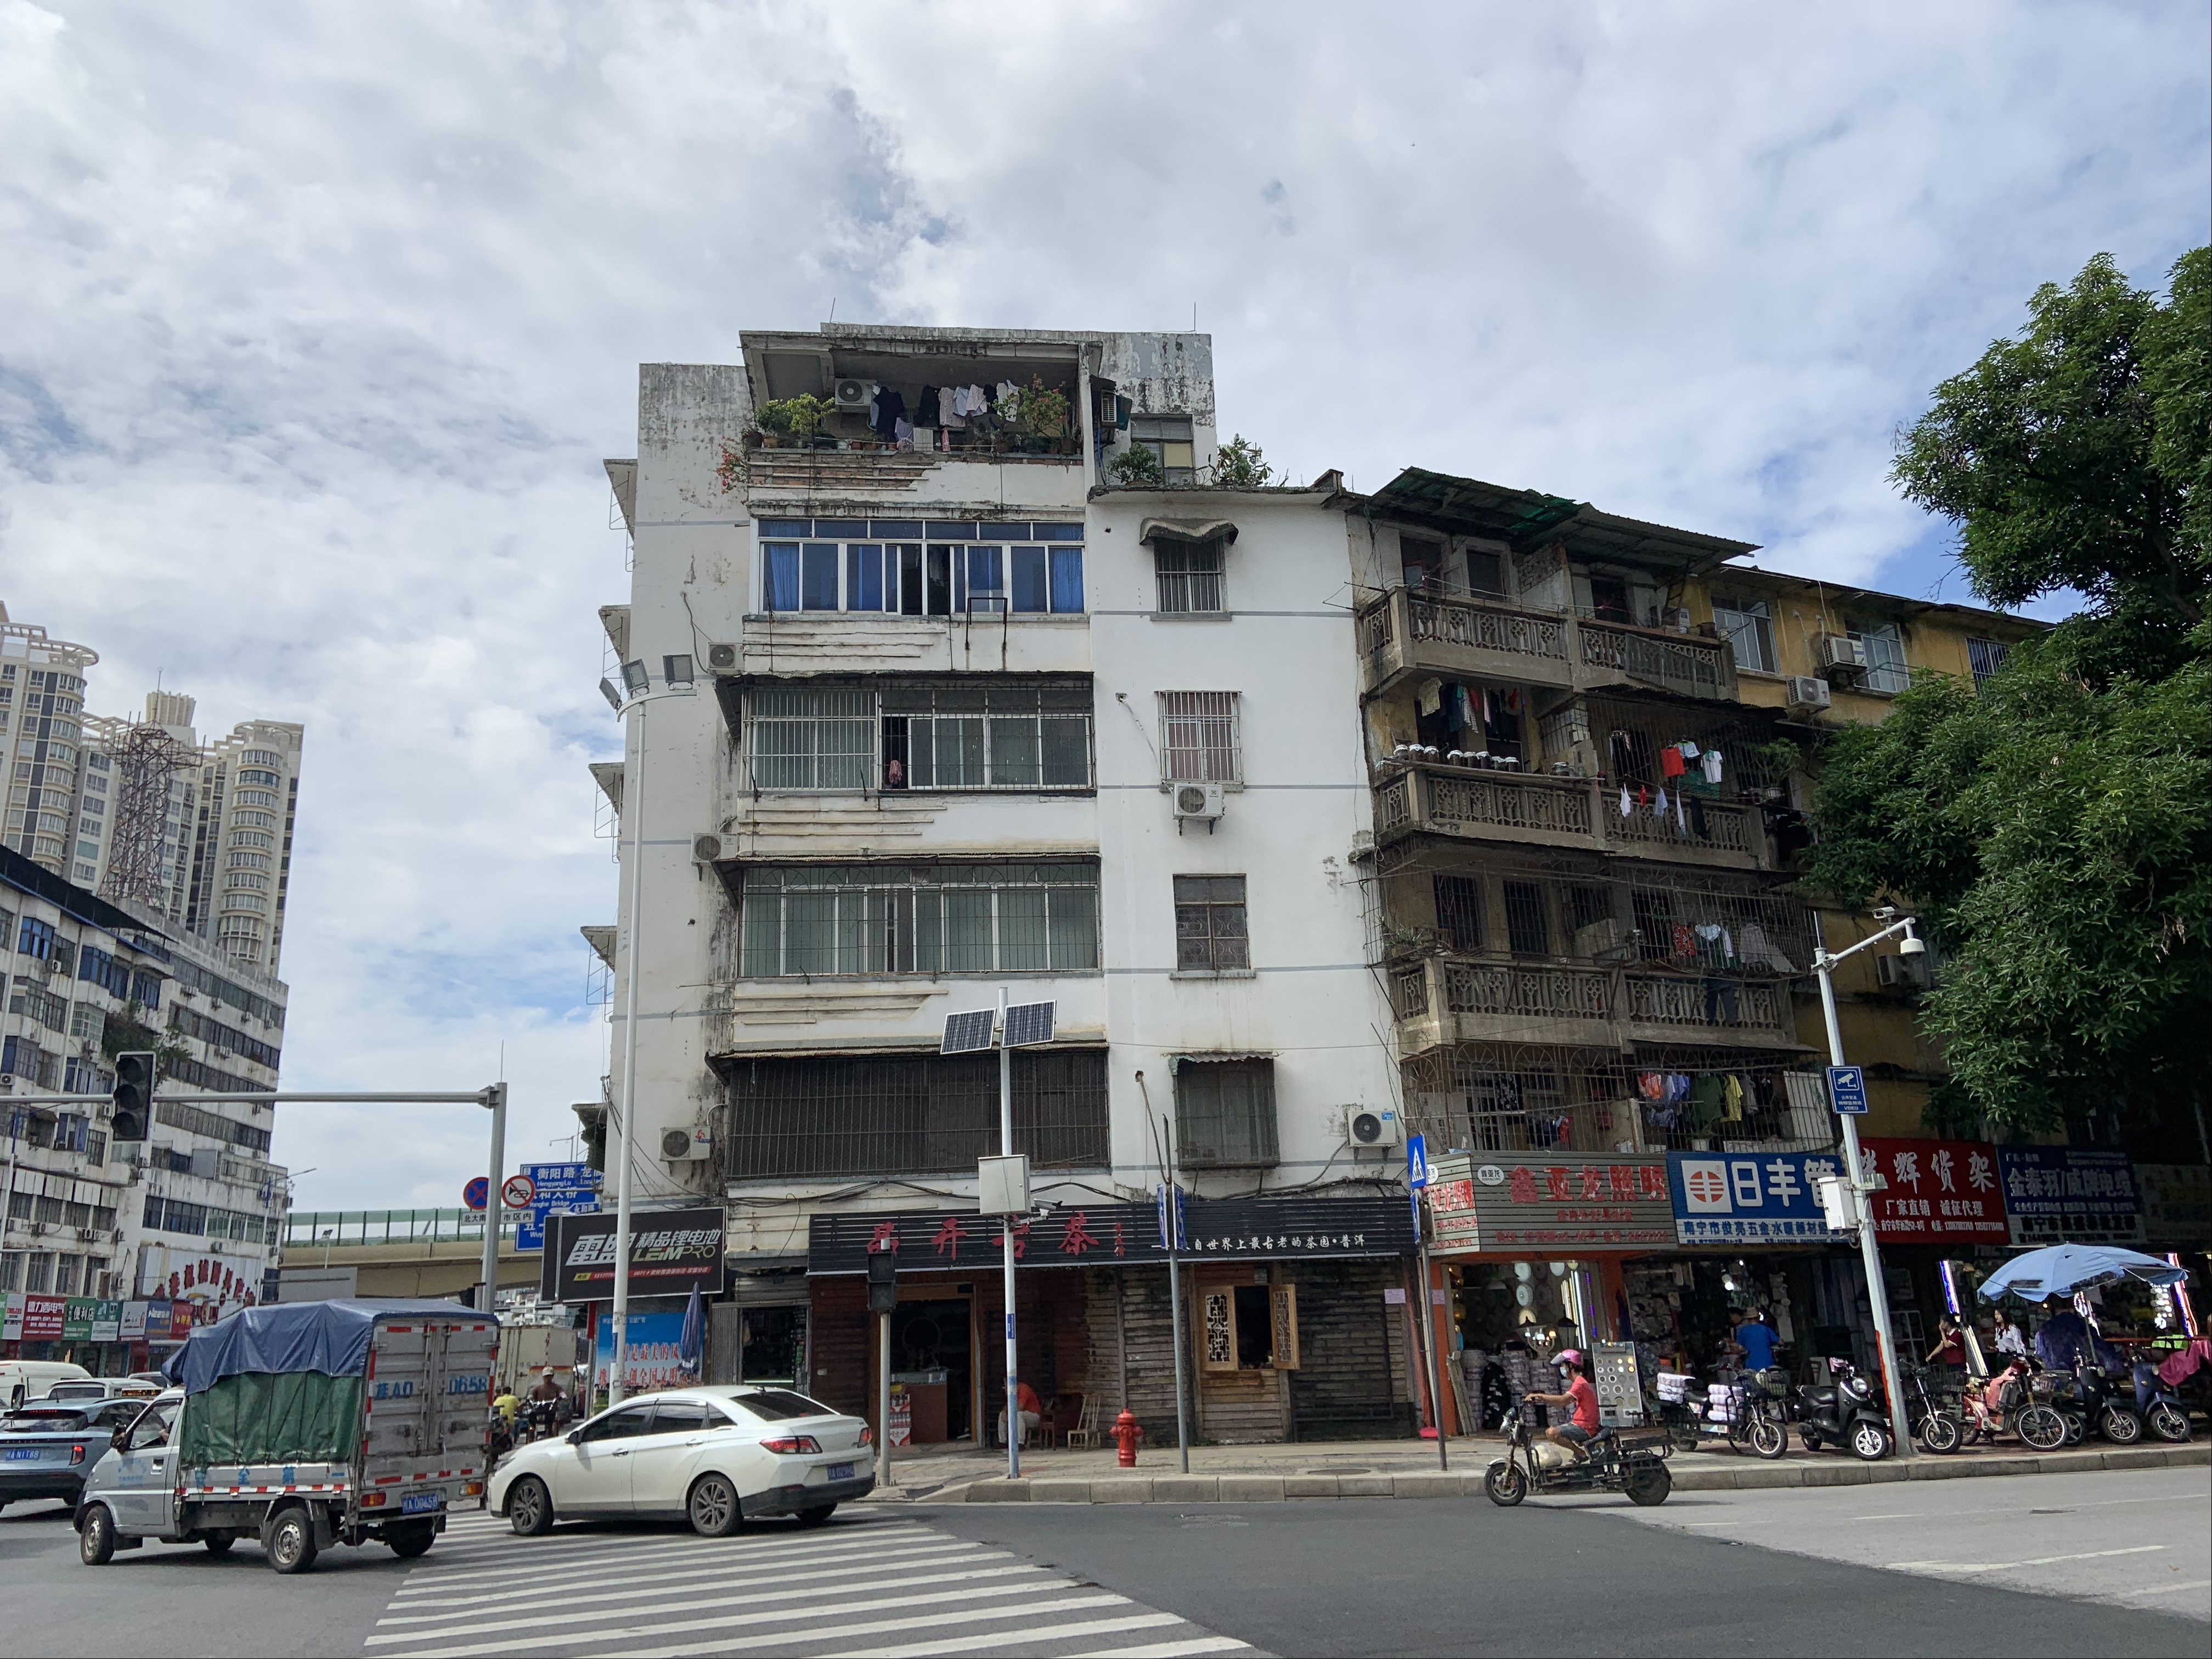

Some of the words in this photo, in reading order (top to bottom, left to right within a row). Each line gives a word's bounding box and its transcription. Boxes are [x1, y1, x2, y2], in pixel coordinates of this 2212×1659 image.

[538, 1167, 575, 1180] 衡阳路
[1508, 1164, 1666, 1203] 鑫亚龙照明
[533, 1187, 578, 1200] 和大桥
[1886, 1199, 1931, 1216] 厂家直销
[1940, 1200, 1984, 1216] 诚征代理
[464, 1214, 486, 1222] 北大南
[503, 1212, 532, 1221] 市区内
[635, 1229, 722, 1248] 精品锂电池
[74, 1305, 95, 1322] 便利店
